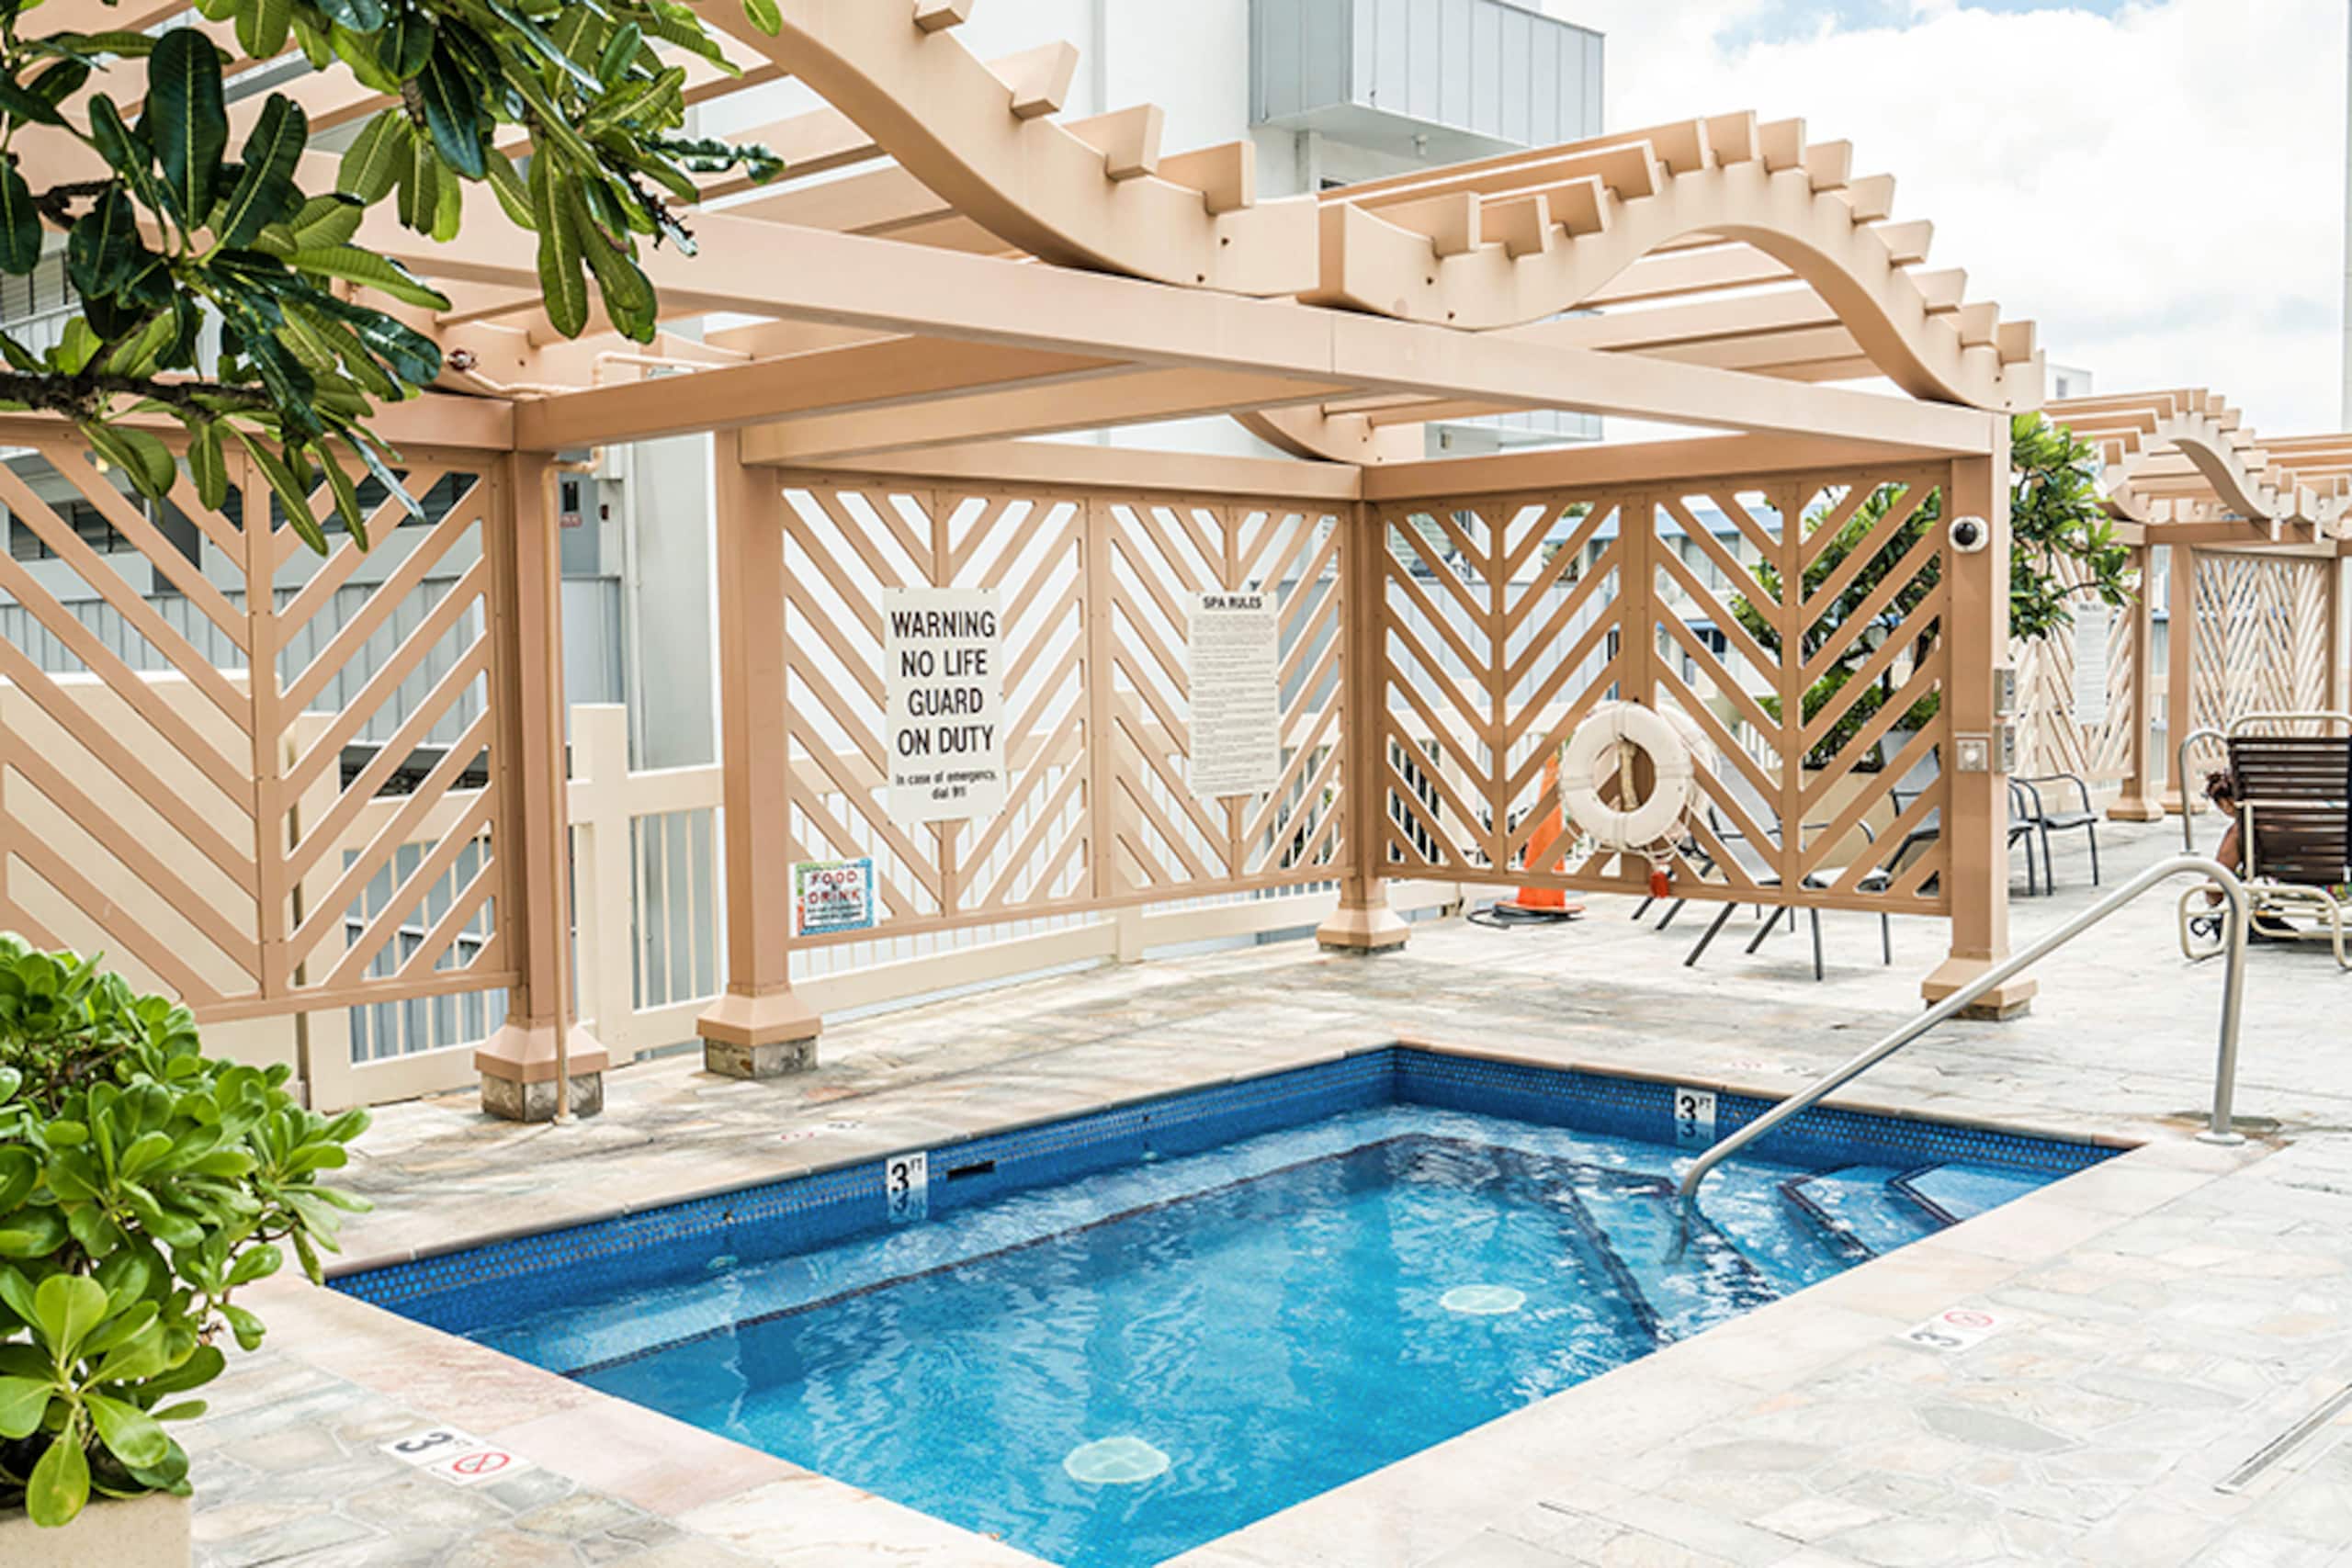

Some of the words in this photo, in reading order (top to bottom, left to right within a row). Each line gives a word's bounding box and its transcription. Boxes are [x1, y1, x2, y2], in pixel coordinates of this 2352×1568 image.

[1204, 595, 1225, 609] SPA
[1229, 595, 1262, 609] RULES
[890, 610, 996, 638] WARNING
[900, 649, 934, 678] NO
[944, 649, 988, 677] LIFE
[908, 687, 984, 716] GUARD
[897, 728, 931, 757] ON
[938, 725, 994, 754] DUTY
[908, 774, 931, 785] case
[934, 771, 944, 784] of
[1680, 1095, 1696, 1121] 3
[891, 1162, 909, 1194] 3
[394, 1431, 453, 1453] 3
